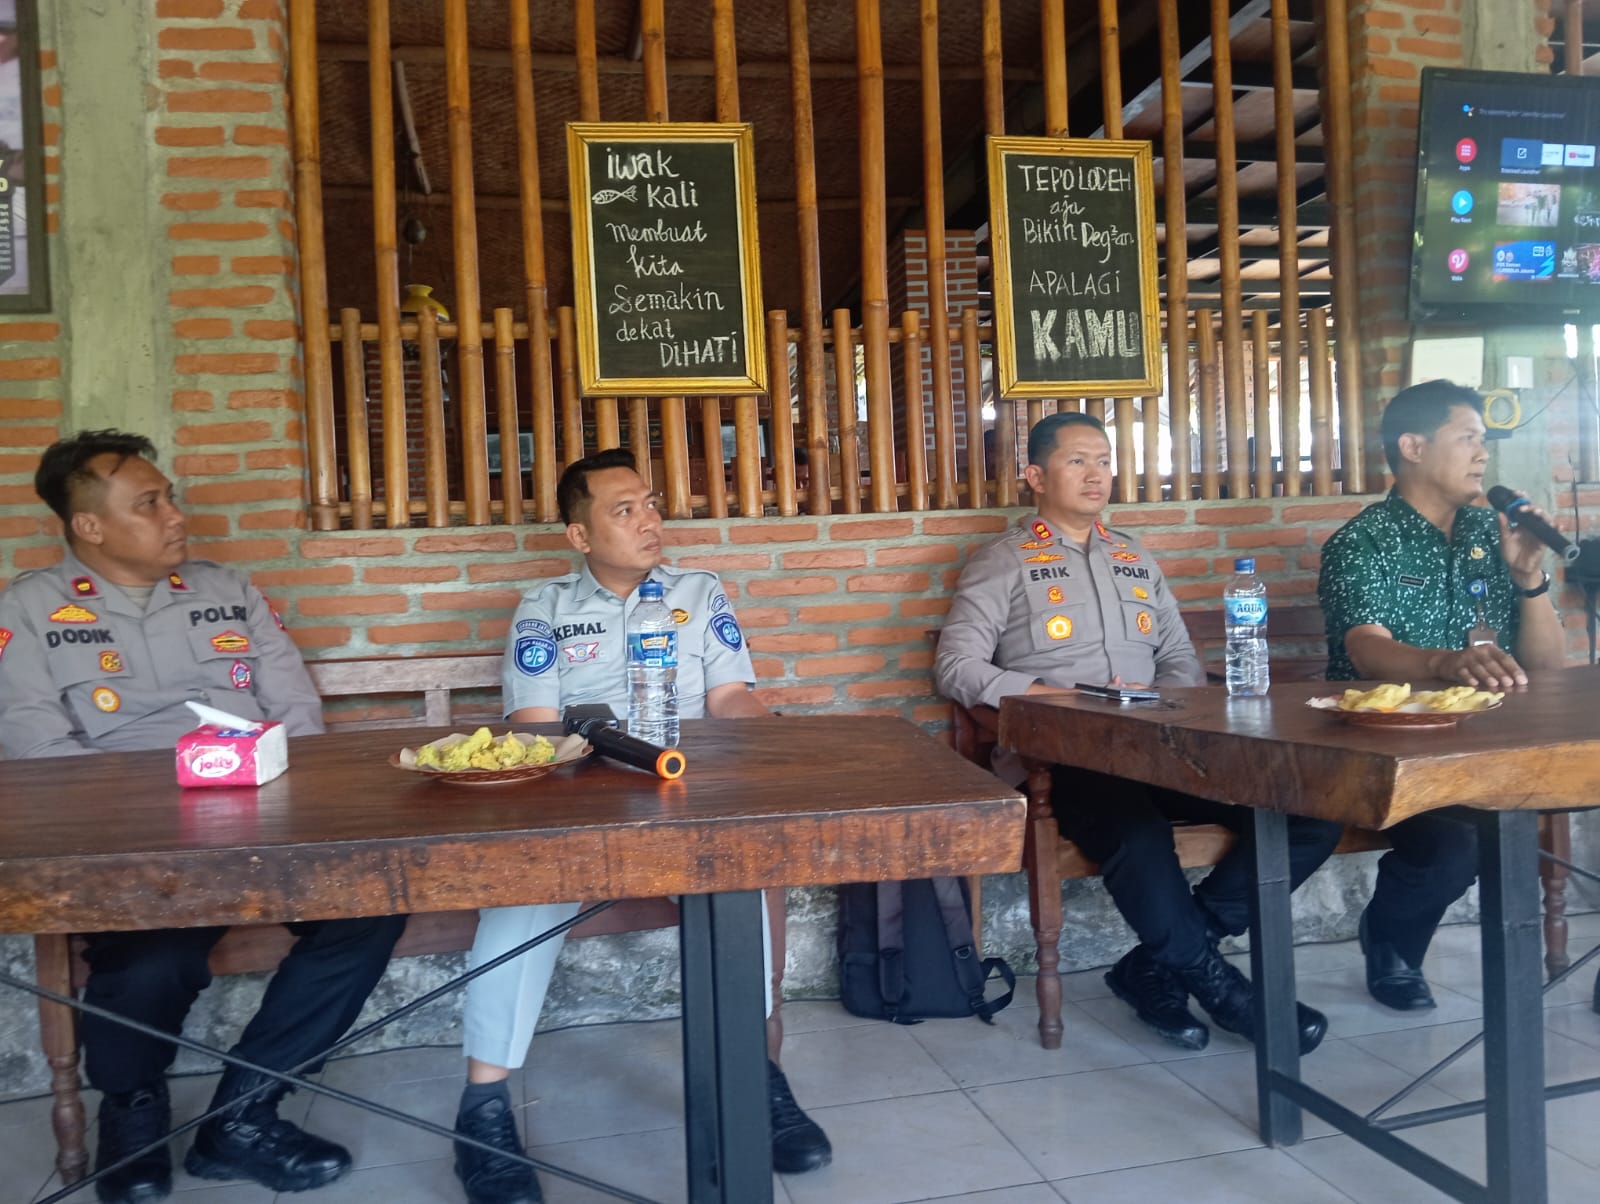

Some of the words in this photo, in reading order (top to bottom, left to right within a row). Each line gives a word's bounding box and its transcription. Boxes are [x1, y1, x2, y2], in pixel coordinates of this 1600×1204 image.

[1030, 308, 1140, 361] KAMU
[1029, 566, 1070, 581] ERIK
[1112, 565, 1150, 580] POLRI
[1236, 603, 1263, 613] AQUA
[46, 628, 114, 648] DODIK
[553, 622, 606, 641] KEMAL
